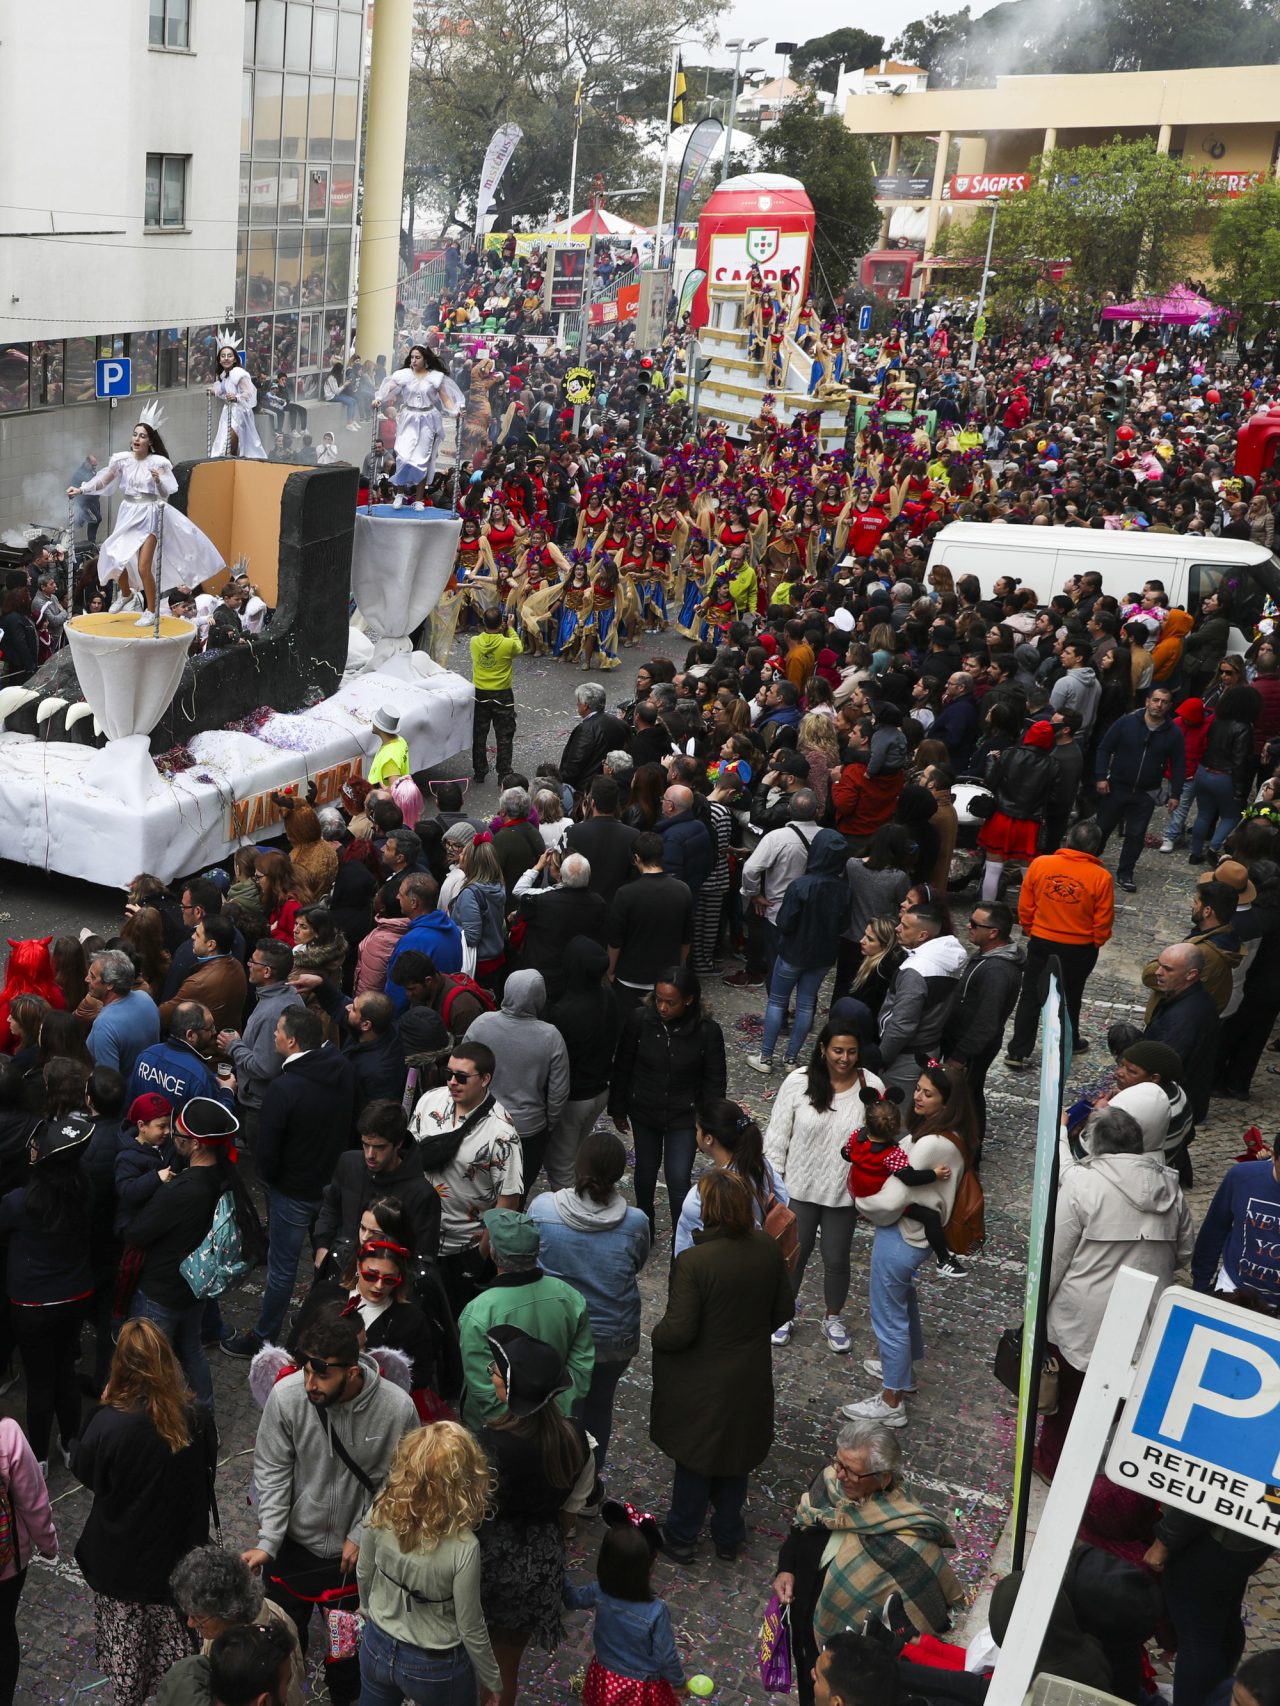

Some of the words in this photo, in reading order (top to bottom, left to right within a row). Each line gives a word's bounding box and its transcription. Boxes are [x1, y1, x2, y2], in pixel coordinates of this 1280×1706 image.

[971, 175, 1025, 193] SAGRES
[104, 363, 123, 393] P
[138, 1062, 186, 1097] FRANCE
[1246, 1210, 1280, 1234] NE
[1159, 1324, 1280, 1442] P
[1143, 1446, 1249, 1498] RETIRE
[1119, 1461, 1139, 1478] O
[1148, 1471, 1206, 1504] SEU
[1214, 1492, 1280, 1536] BILH
